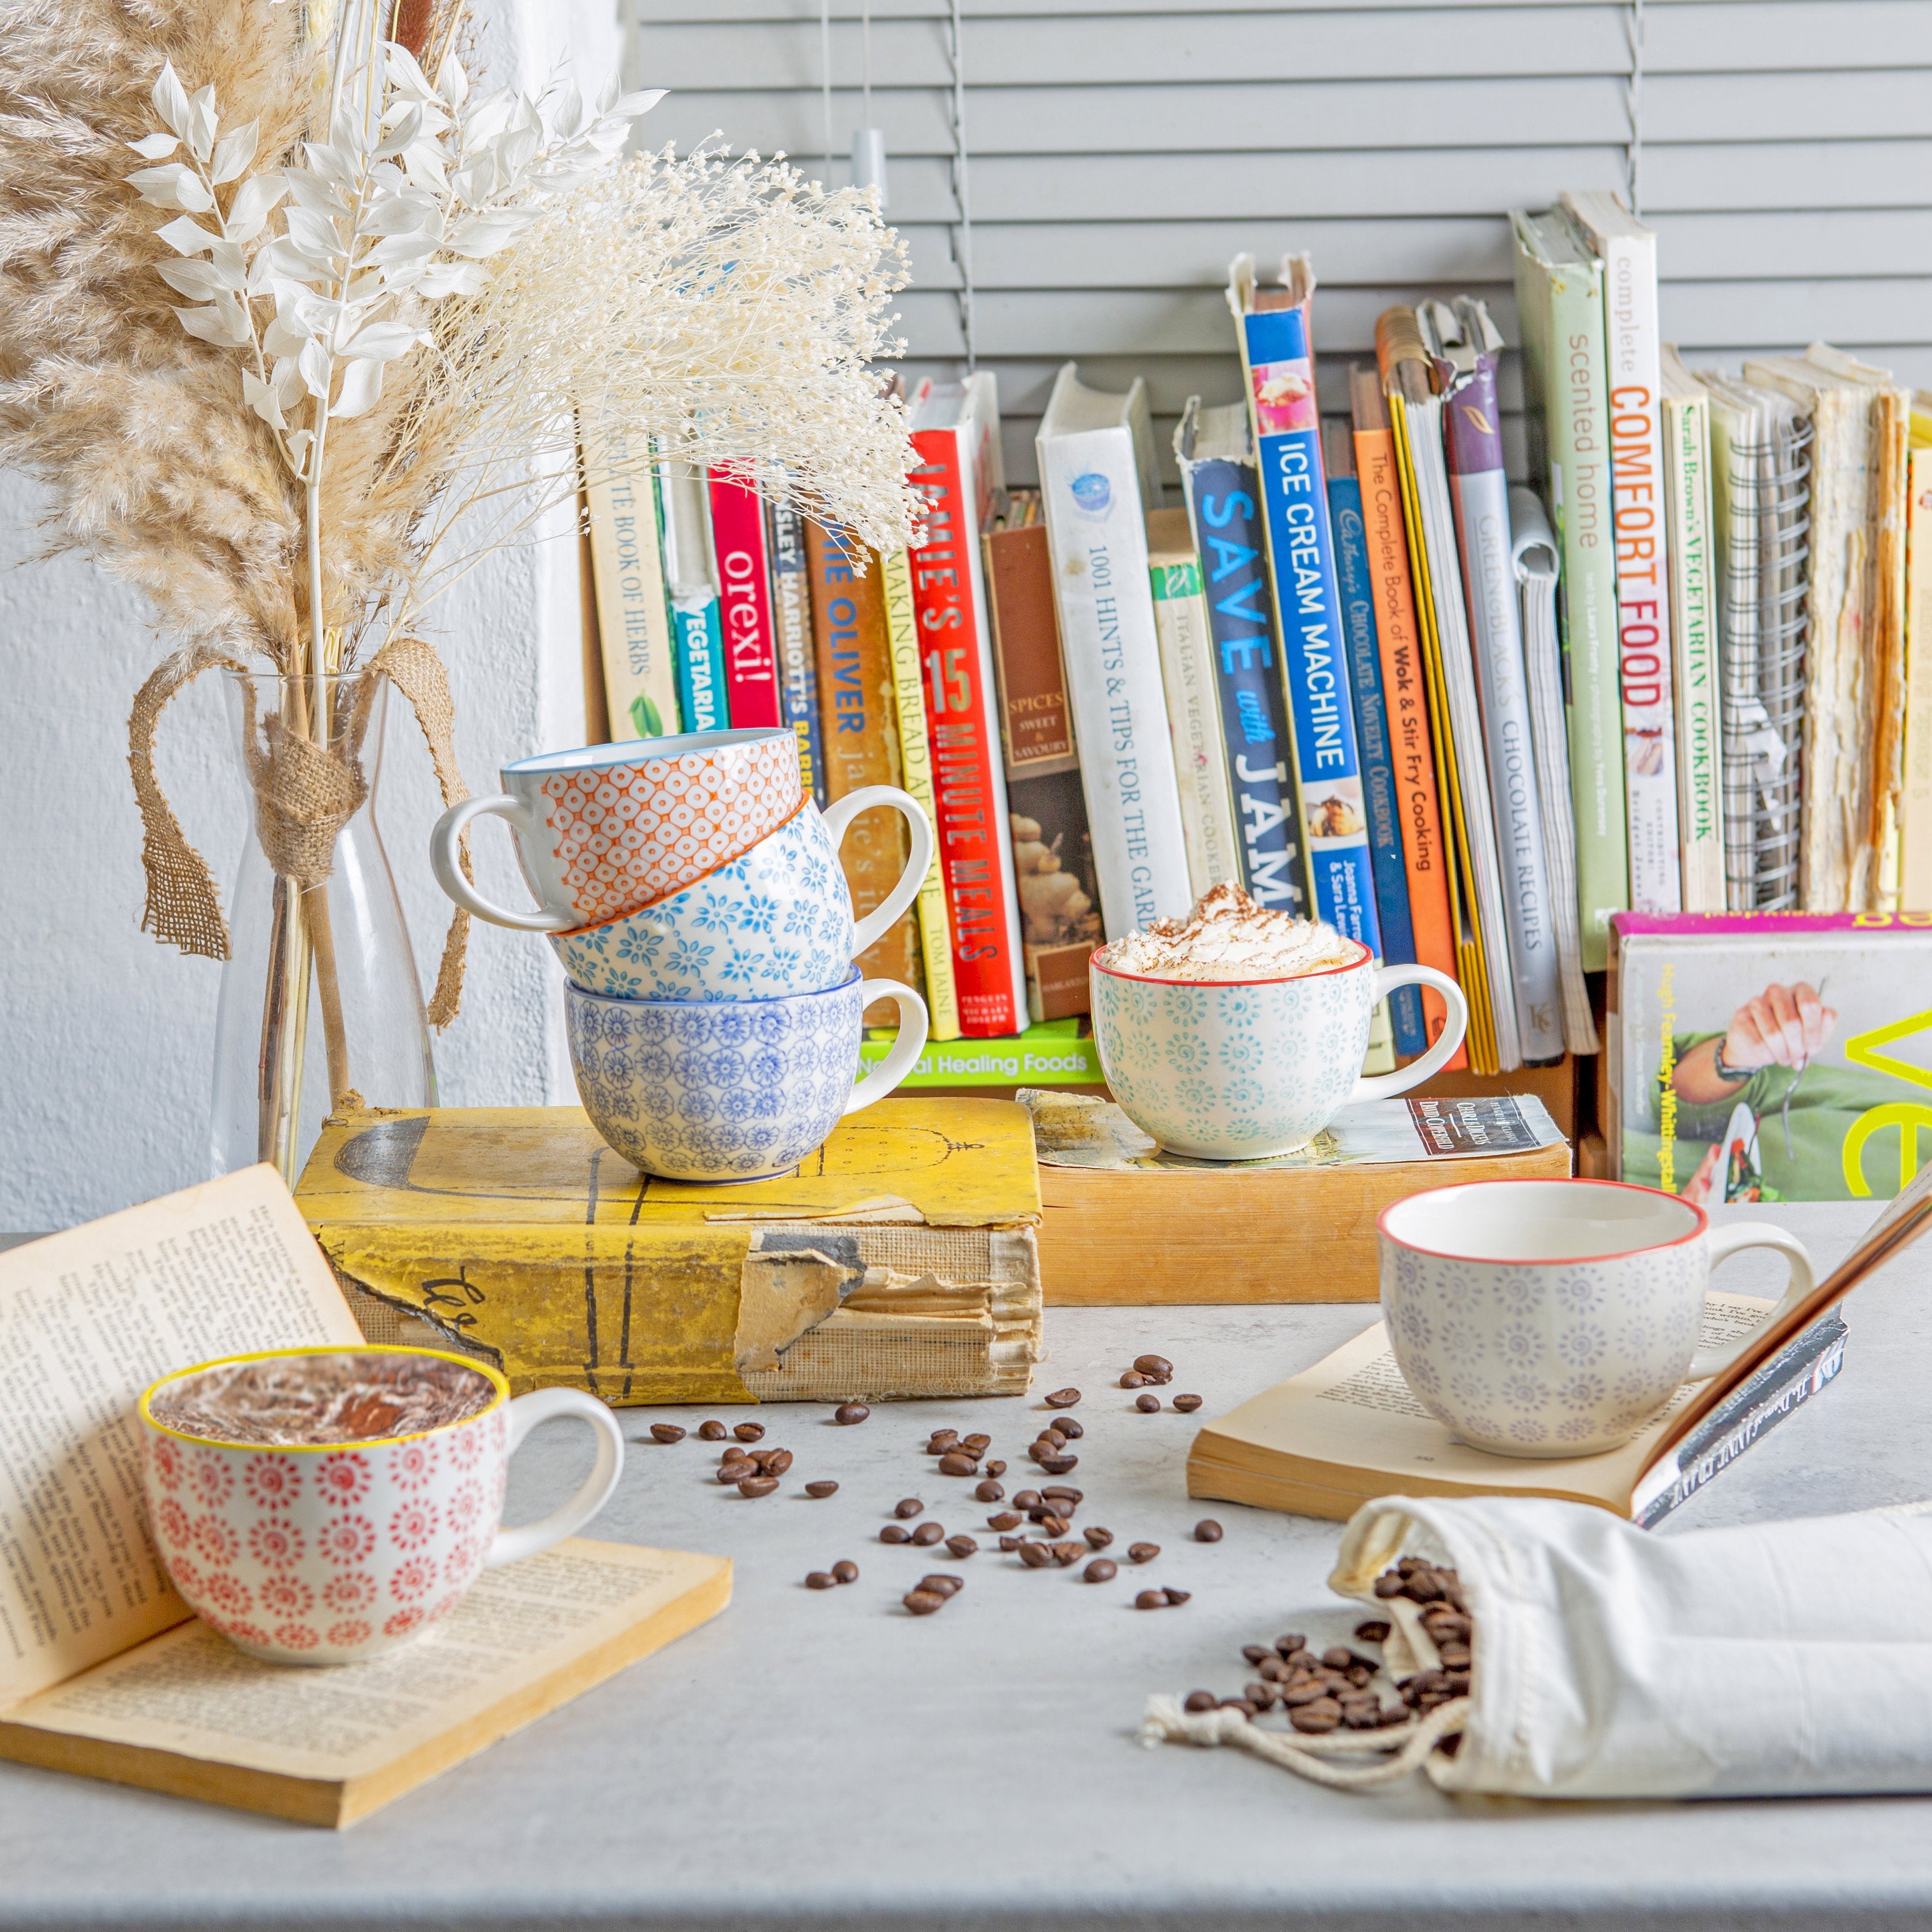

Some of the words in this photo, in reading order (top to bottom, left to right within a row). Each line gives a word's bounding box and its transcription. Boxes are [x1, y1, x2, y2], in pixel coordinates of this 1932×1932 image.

[1612, 256, 1640, 373] complete
[1568, 333, 1600, 453] scented
[1680, 404, 1696, 455] Sarah
[1278, 442, 1311, 495] ICE
[1370, 452, 1390, 485] The
[1610, 385, 1658, 586] COMFORT
[1683, 461, 1699, 532] Brown's
[772, 492, 796, 566] NSLEY
[1370, 488, 1400, 572] Complete
[1575, 463, 1605, 549] home
[613, 515, 640, 571] BOOK
[908, 463, 962, 631] JAMIE'S
[1089, 544, 1112, 589] 1001
[1285, 501, 1326, 615] CREAM
[620, 575, 644, 603] OF
[882, 550, 915, 666] MAKING
[1200, 488, 1273, 675] SAVE
[1384, 577, 1405, 617] Book
[1684, 537, 1706, 687] VEGETARIAN
[623, 609, 652, 676] HERBS
[723, 549, 773, 683] orexi!
[778, 571, 809, 714] HARRIOTT'S
[1095, 597, 1124, 672] HINTS
[1347, 598, 1378, 689] CHOCOLATE
[1389, 623, 1408, 642] of
[826, 597, 867, 735] OLIVER
[925, 648, 972, 714] 15
[1392, 645, 1413, 691] Wok
[1618, 599, 1661, 707] FOOD
[896, 672, 926, 765] BREAD
[1106, 676, 1126, 697] &
[1235, 686, 1276, 745] with
[1300, 622, 1344, 769] MACHINE
[1398, 697, 1414, 712] &
[1109, 700, 1134, 752] TIPS
[1359, 693, 1387, 761] NOVELTY
[1401, 717, 1420, 750] Stir
[934, 721, 985, 845] MINUTE
[1116, 758, 1141, 805] FOR
[1402, 754, 1424, 787] Fry
[1689, 700, 1712, 840] COOKBOOK
[838, 744, 885, 871] jaie's
[1123, 808, 1148, 860] THE
[1234, 749, 1302, 909] JAM
[1368, 765, 1396, 847] COOKBOOK
[1408, 790, 1435, 871] Cooking
[1499, 719, 1533, 857] CHOCOLATE
[1516, 864, 1543, 951] RECIPES
[1329, 861, 1343, 873] &
[1331, 874, 1346, 904] Sara
[1343, 859, 1359, 905] Joanna
[950, 857, 998, 962] MEALS
[1334, 904, 1350, 937] Lewi
[929, 927, 946, 966] TOM
[933, 970, 952, 1017] JAINE
[1657, 963, 1676, 1008] Hugh
[858, 1055, 932, 1074] Naal
[938, 1054, 1019, 1076] Healing
[1024, 1053, 1087, 1072] Foods
[1419, 1101, 1440, 1118] DAVID
[1426, 1118, 1454, 1149] COPPERFIELD
[1466, 1125, 1491, 1145] DICKENS
[1502, 1126, 1519, 1142] CLASSICS
